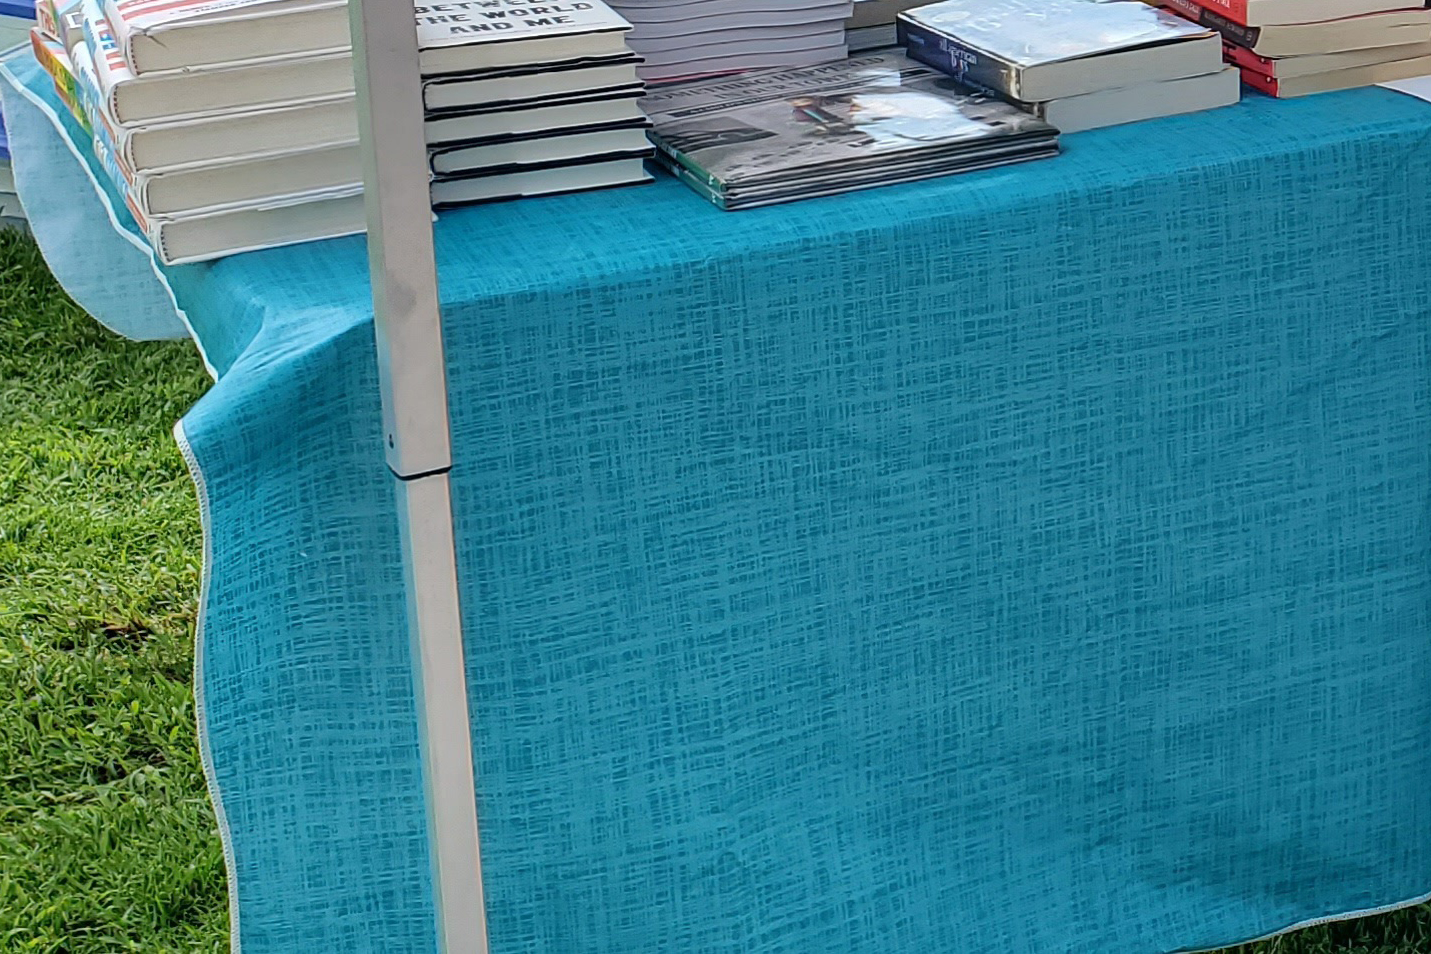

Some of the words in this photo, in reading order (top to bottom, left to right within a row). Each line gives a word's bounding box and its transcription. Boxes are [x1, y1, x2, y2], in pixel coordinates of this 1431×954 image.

[478, 2, 593, 19] WORLD
[450, 22, 514, 34] AND
[523, 15, 575, 27] ME
